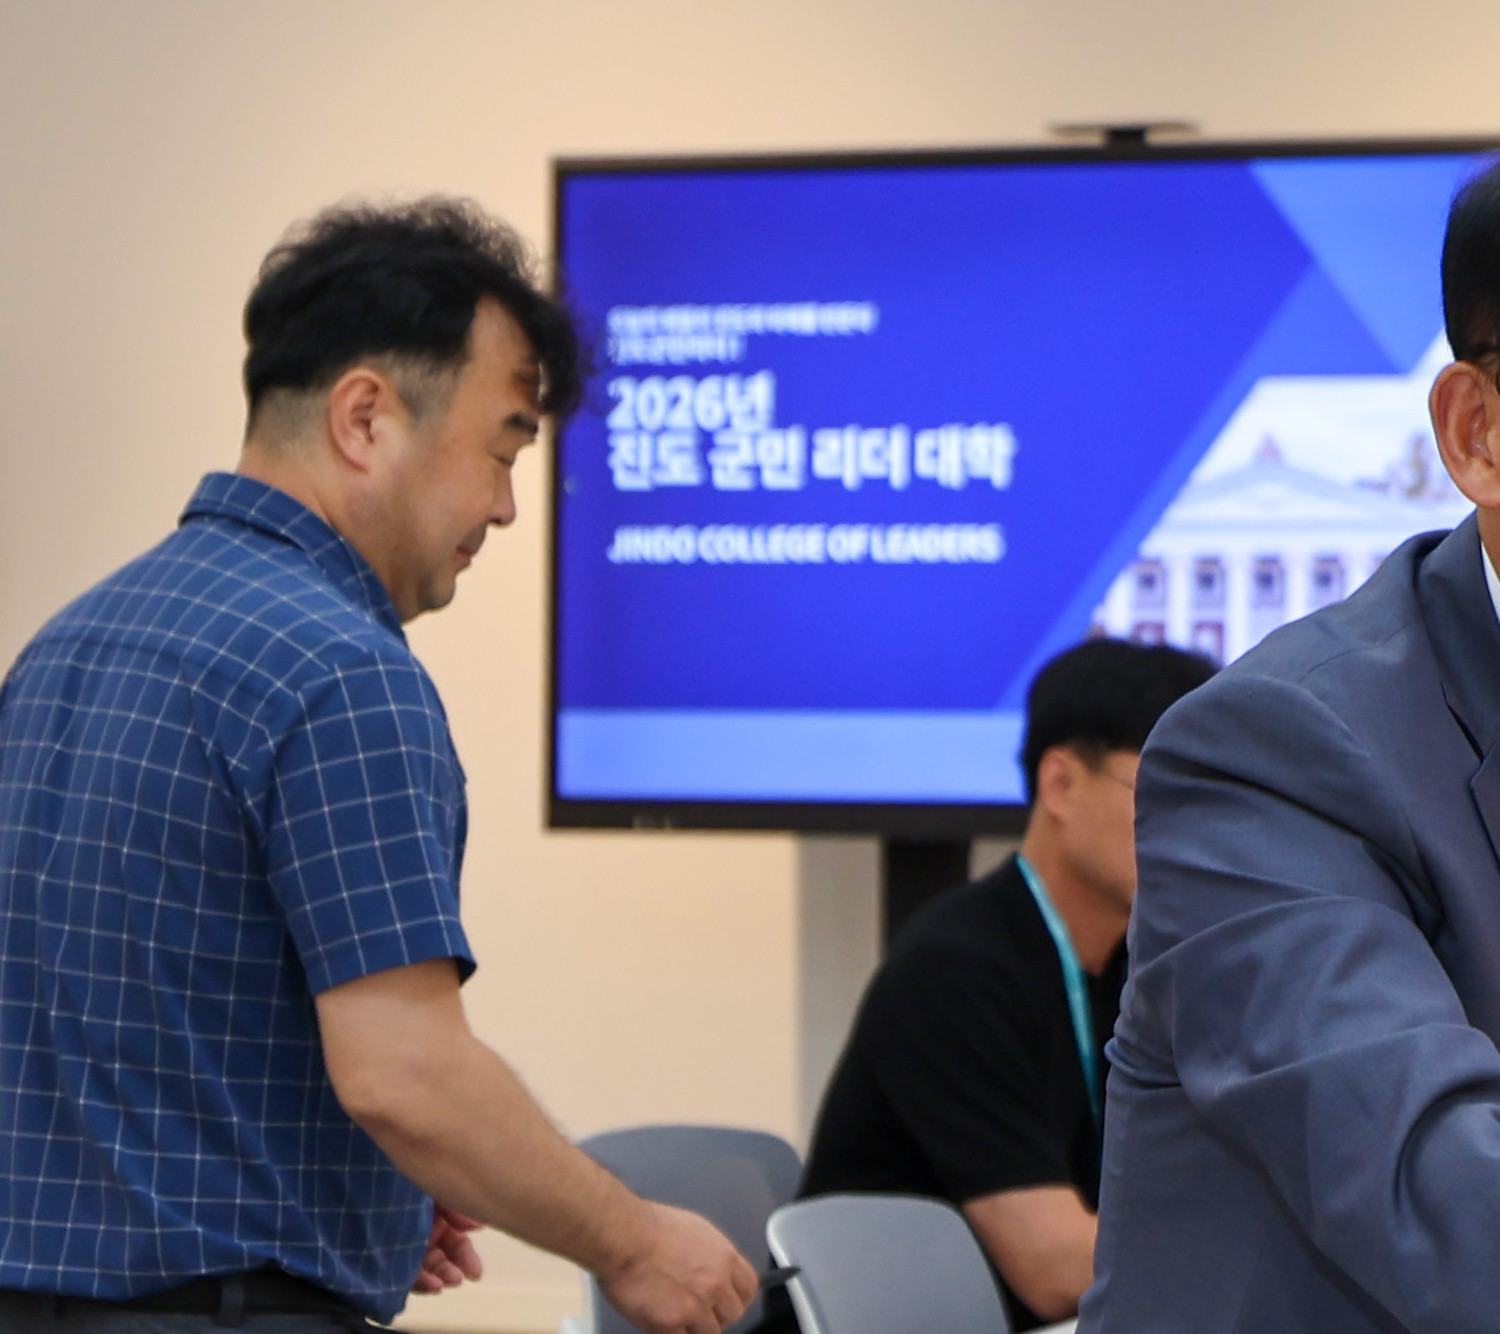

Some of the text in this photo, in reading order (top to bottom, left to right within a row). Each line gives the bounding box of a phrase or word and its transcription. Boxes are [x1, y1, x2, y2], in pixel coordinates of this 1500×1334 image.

[607, 369, 775, 432] 2026년
[607, 422, 1019, 491] 진도 군민 리더 대학
[607, 522, 1005, 564] JINDO COLLEGE OF LEADERS
